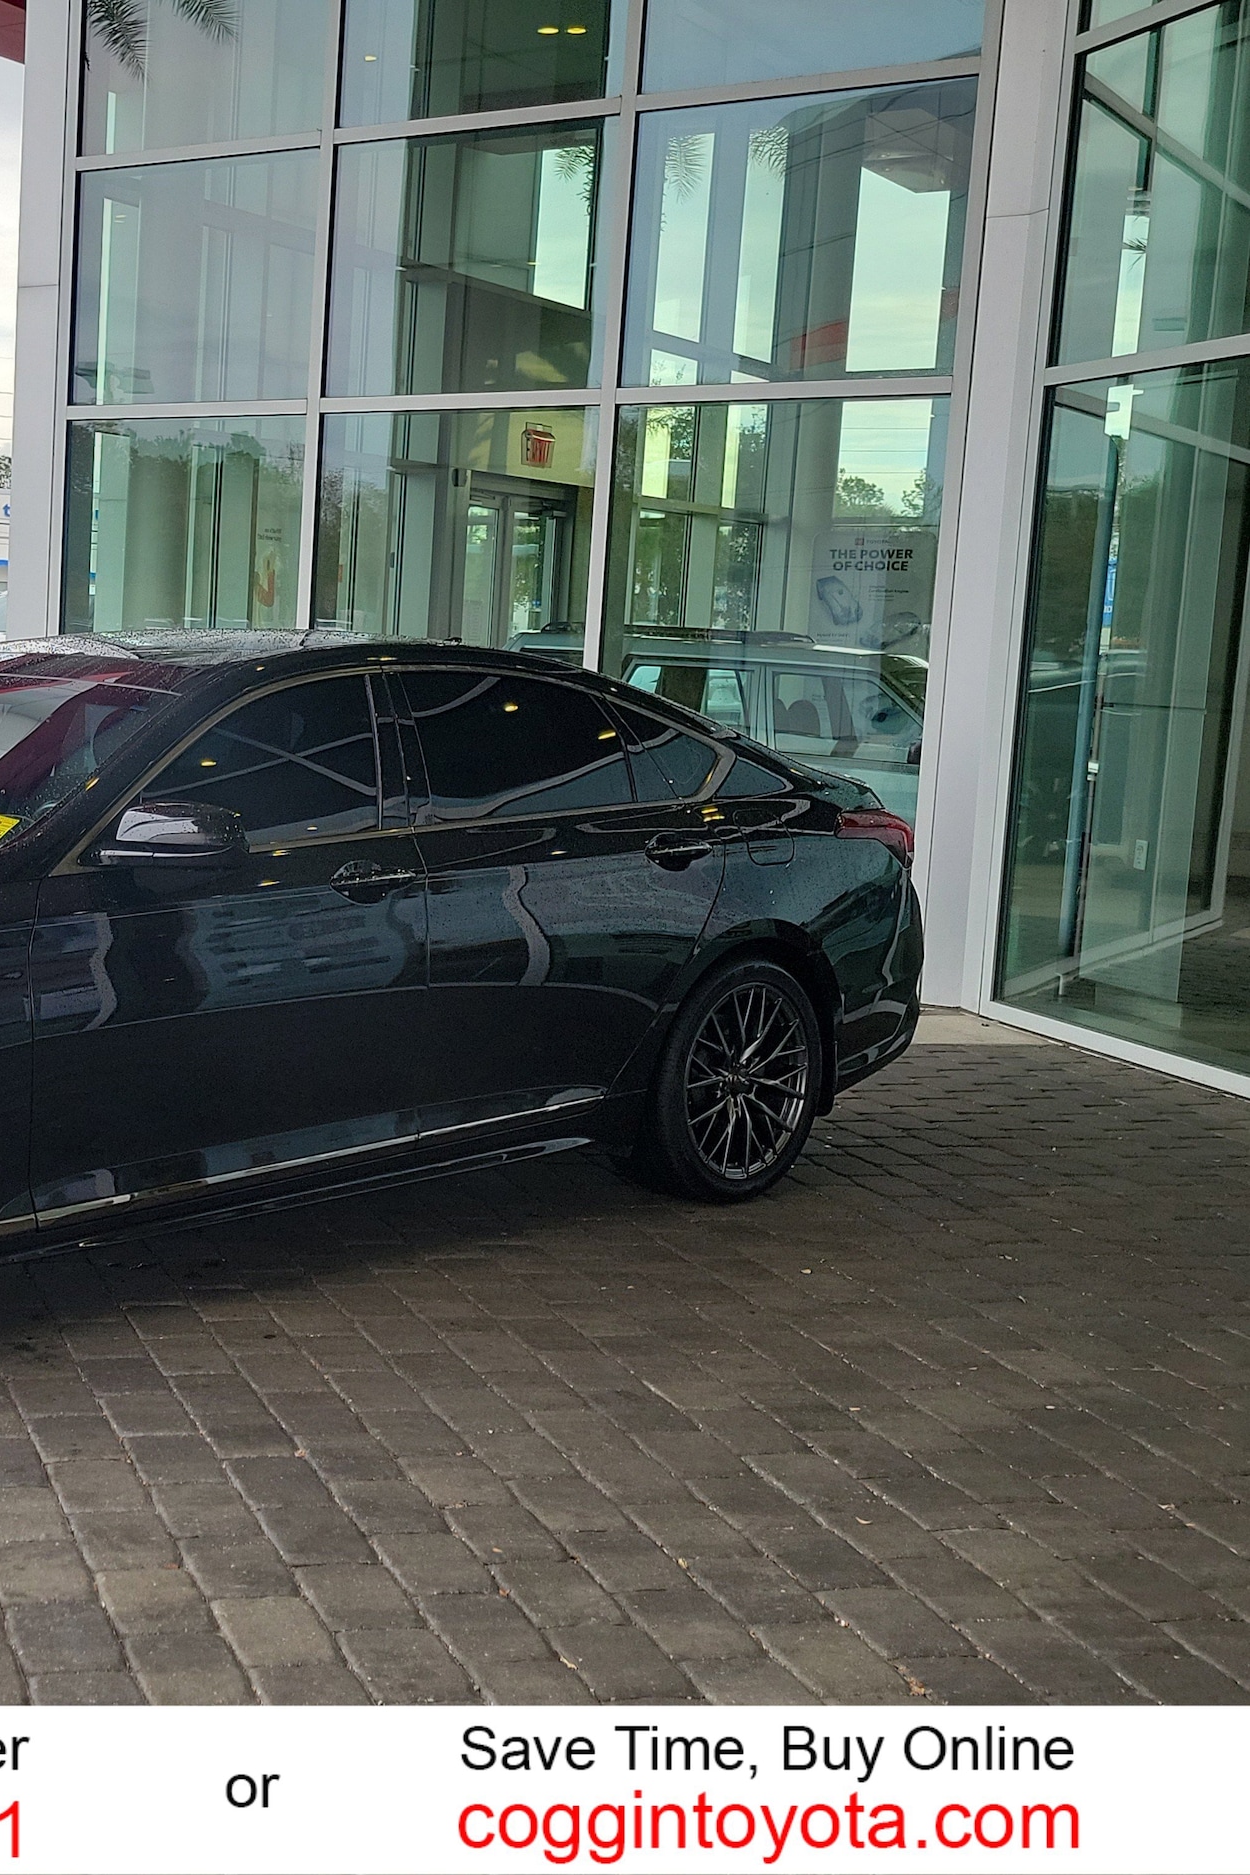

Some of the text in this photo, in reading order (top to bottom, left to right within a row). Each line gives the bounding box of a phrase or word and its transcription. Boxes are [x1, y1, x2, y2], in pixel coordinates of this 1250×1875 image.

[829, 549, 913, 559] THE POWER
[833, 561, 908, 571] OF CHOICE
